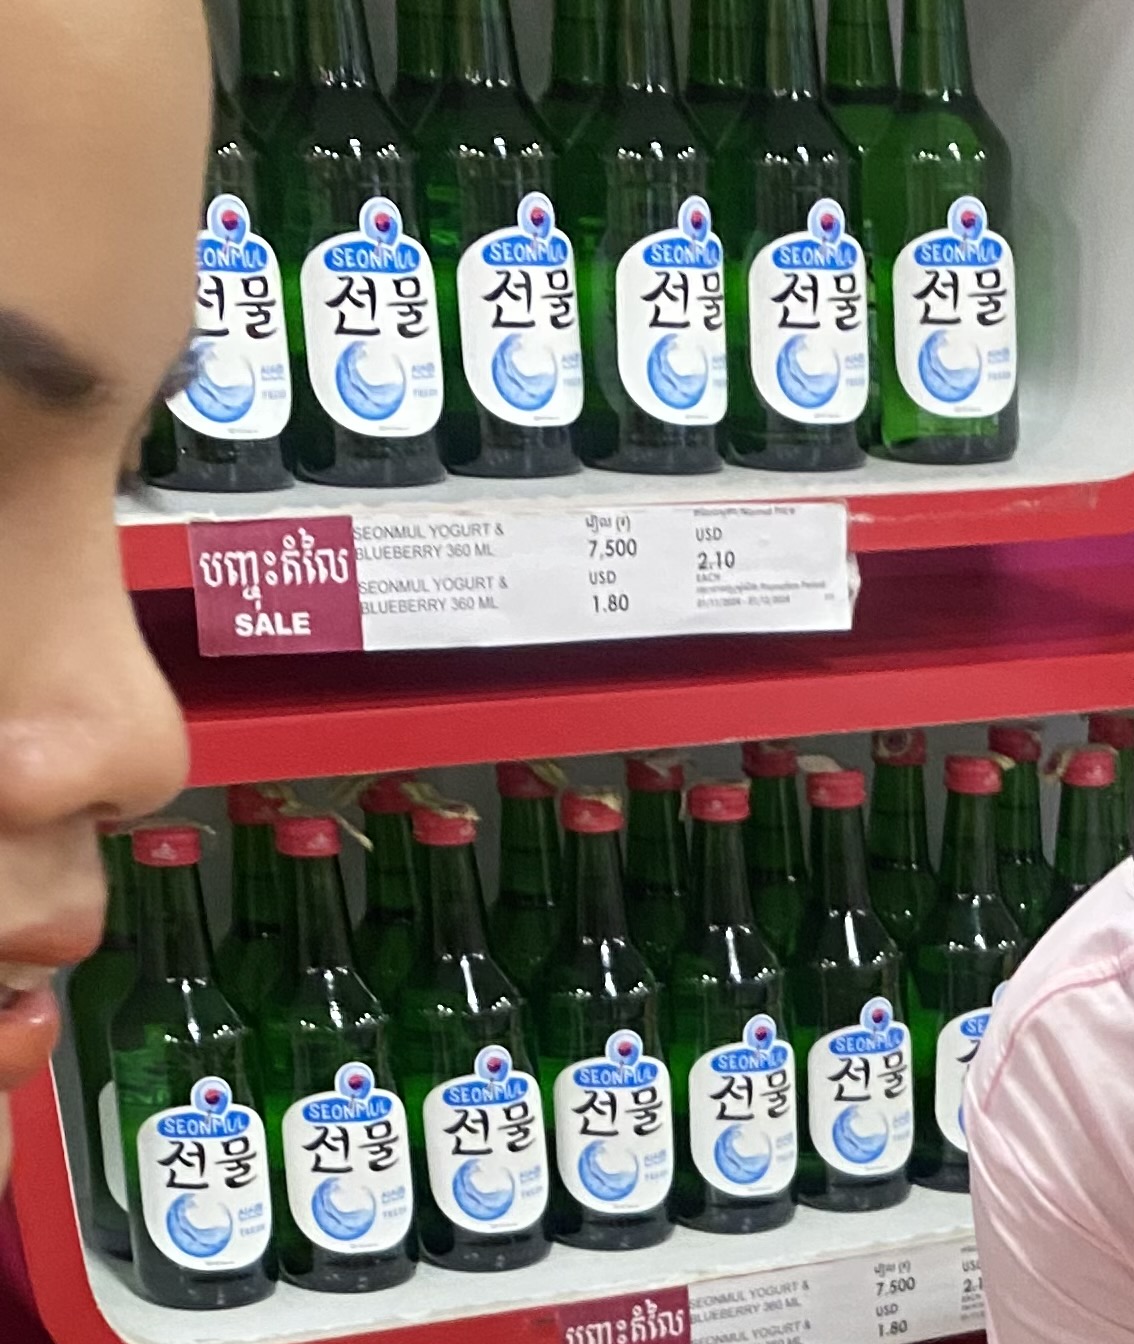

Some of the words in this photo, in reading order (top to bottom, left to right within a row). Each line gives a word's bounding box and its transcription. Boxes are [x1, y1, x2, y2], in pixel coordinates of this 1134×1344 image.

[331, 247, 418, 271] SEONMUL
[490, 240, 568, 263] SEONMUL
[353, 524, 425, 540] SEONMUL
[431, 523, 493, 538] YOGURT
[495, 523, 504, 536] &
[696, 527, 722, 541] USD
[356, 546, 442, 560] BLUEBERRY
[447, 545, 471, 557] 360
[474, 544, 495, 556] ML
[697, 551, 735, 570] 2.10
[359, 579, 429, 594] SEONMUL
[434, 577, 494, 592] YOGURT
[498, 577, 508, 589] &
[589, 571, 616, 585] USD
[361, 598, 446, 614] BLUEBERRY
[450, 597, 475, 611] 360
[478, 596, 499, 609] ML
[592, 593, 629, 612] 1.80
[235, 611, 311, 637] SALE
[309, 1098, 391, 1120] SEONMUL
[163, 1115, 246, 1136] SEONMUL
[876, 1303, 899, 1317] USD
[878, 1320, 908, 1337] 1.80
